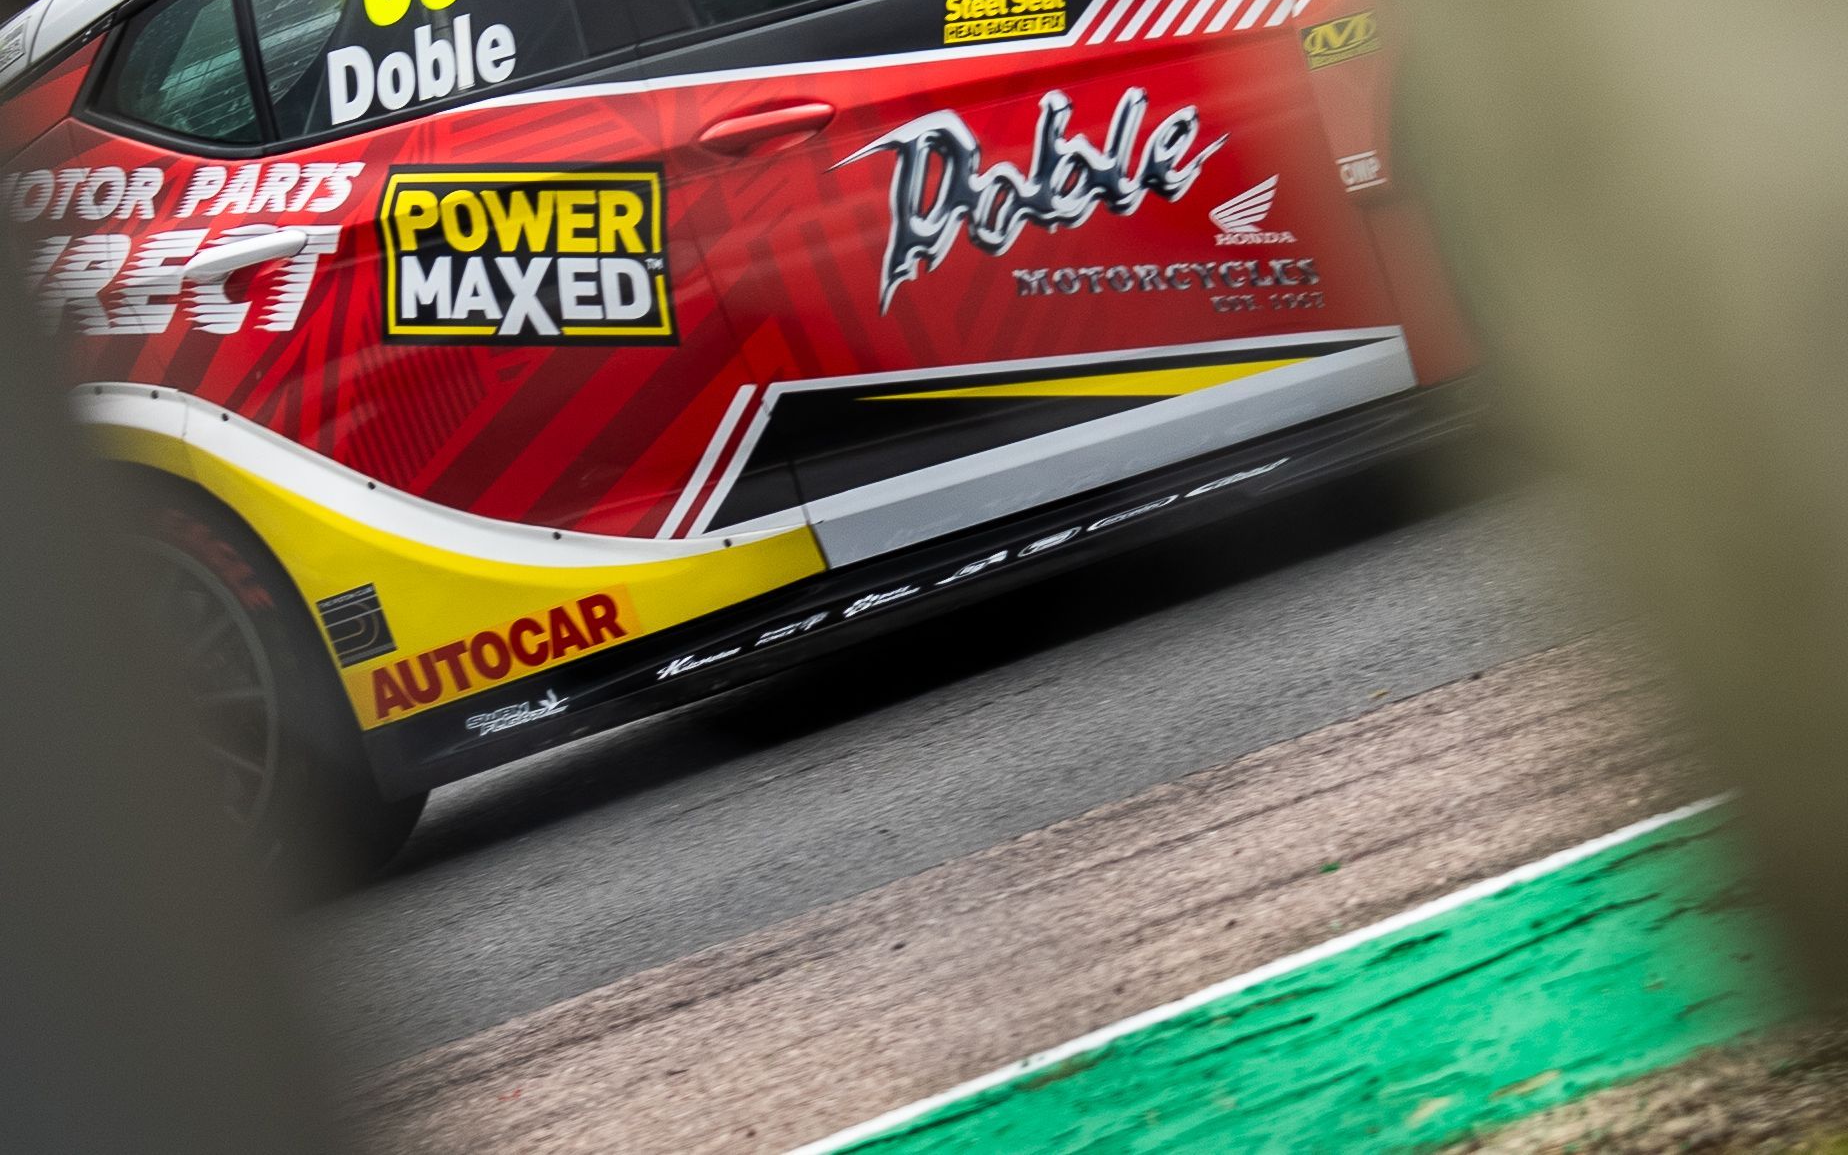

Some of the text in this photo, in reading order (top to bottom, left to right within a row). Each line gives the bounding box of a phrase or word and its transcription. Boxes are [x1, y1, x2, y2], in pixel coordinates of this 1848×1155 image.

[947, 22, 982, 39] HEAD
[327, 13, 517, 125] Doble
[172, 162, 366, 219] PARTS
[394, 189, 647, 253] POWER
[824, 86, 1231, 317] Doble
[1214, 231, 1298, 246] HONDA
[401, 255, 652, 336] MAXED
[1012, 258, 1320, 296] MOTORCYCLES
[372, 592, 628, 721] AUTOCAR
